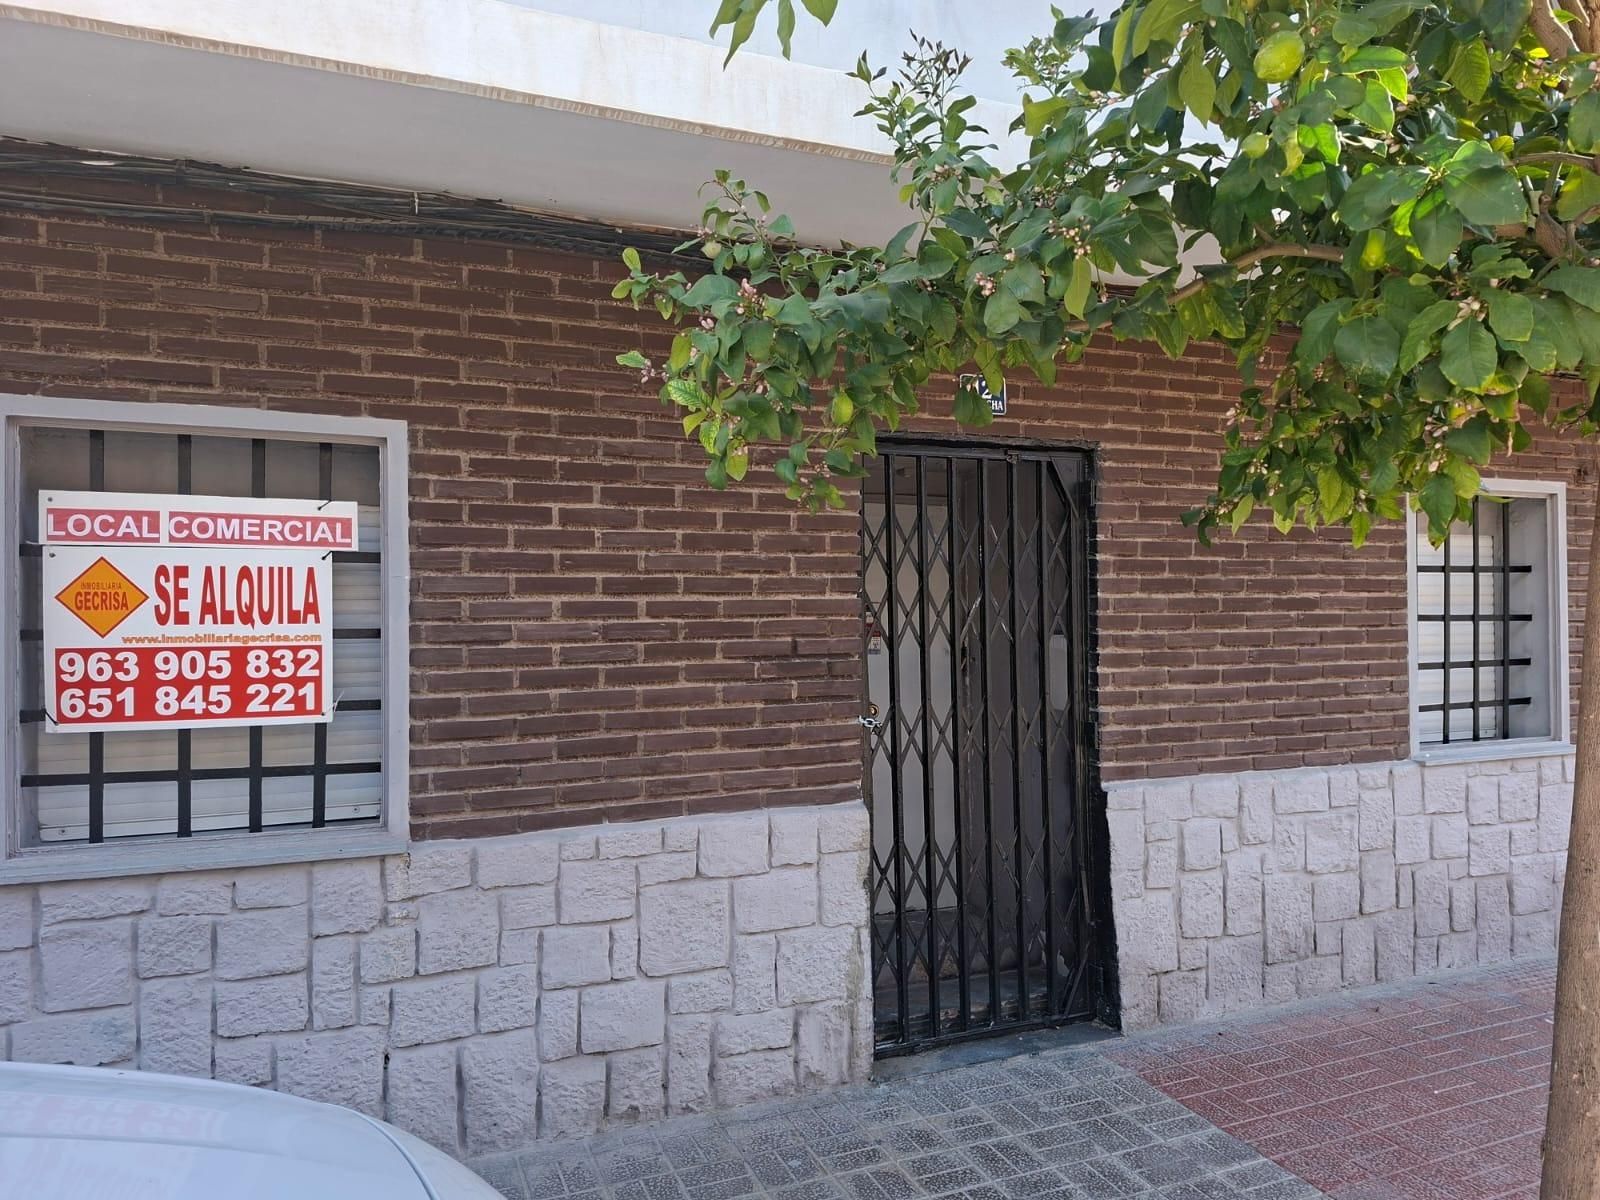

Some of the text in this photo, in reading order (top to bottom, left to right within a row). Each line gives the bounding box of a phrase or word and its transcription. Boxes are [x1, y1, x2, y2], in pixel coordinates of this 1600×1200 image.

[47, 513, 352, 543] LOCAL COMERCIAL
[81, 581, 122, 590] INMOBILIARIA
[154, 564, 321, 630] SE ALQUILA
[75, 591, 129, 611] GECRISA
[121, 633, 322, 645] www.inmobiliariagecrisa.com
[59, 649, 320, 683] 963 905 832
[60, 682, 316, 718] 651 845 221
